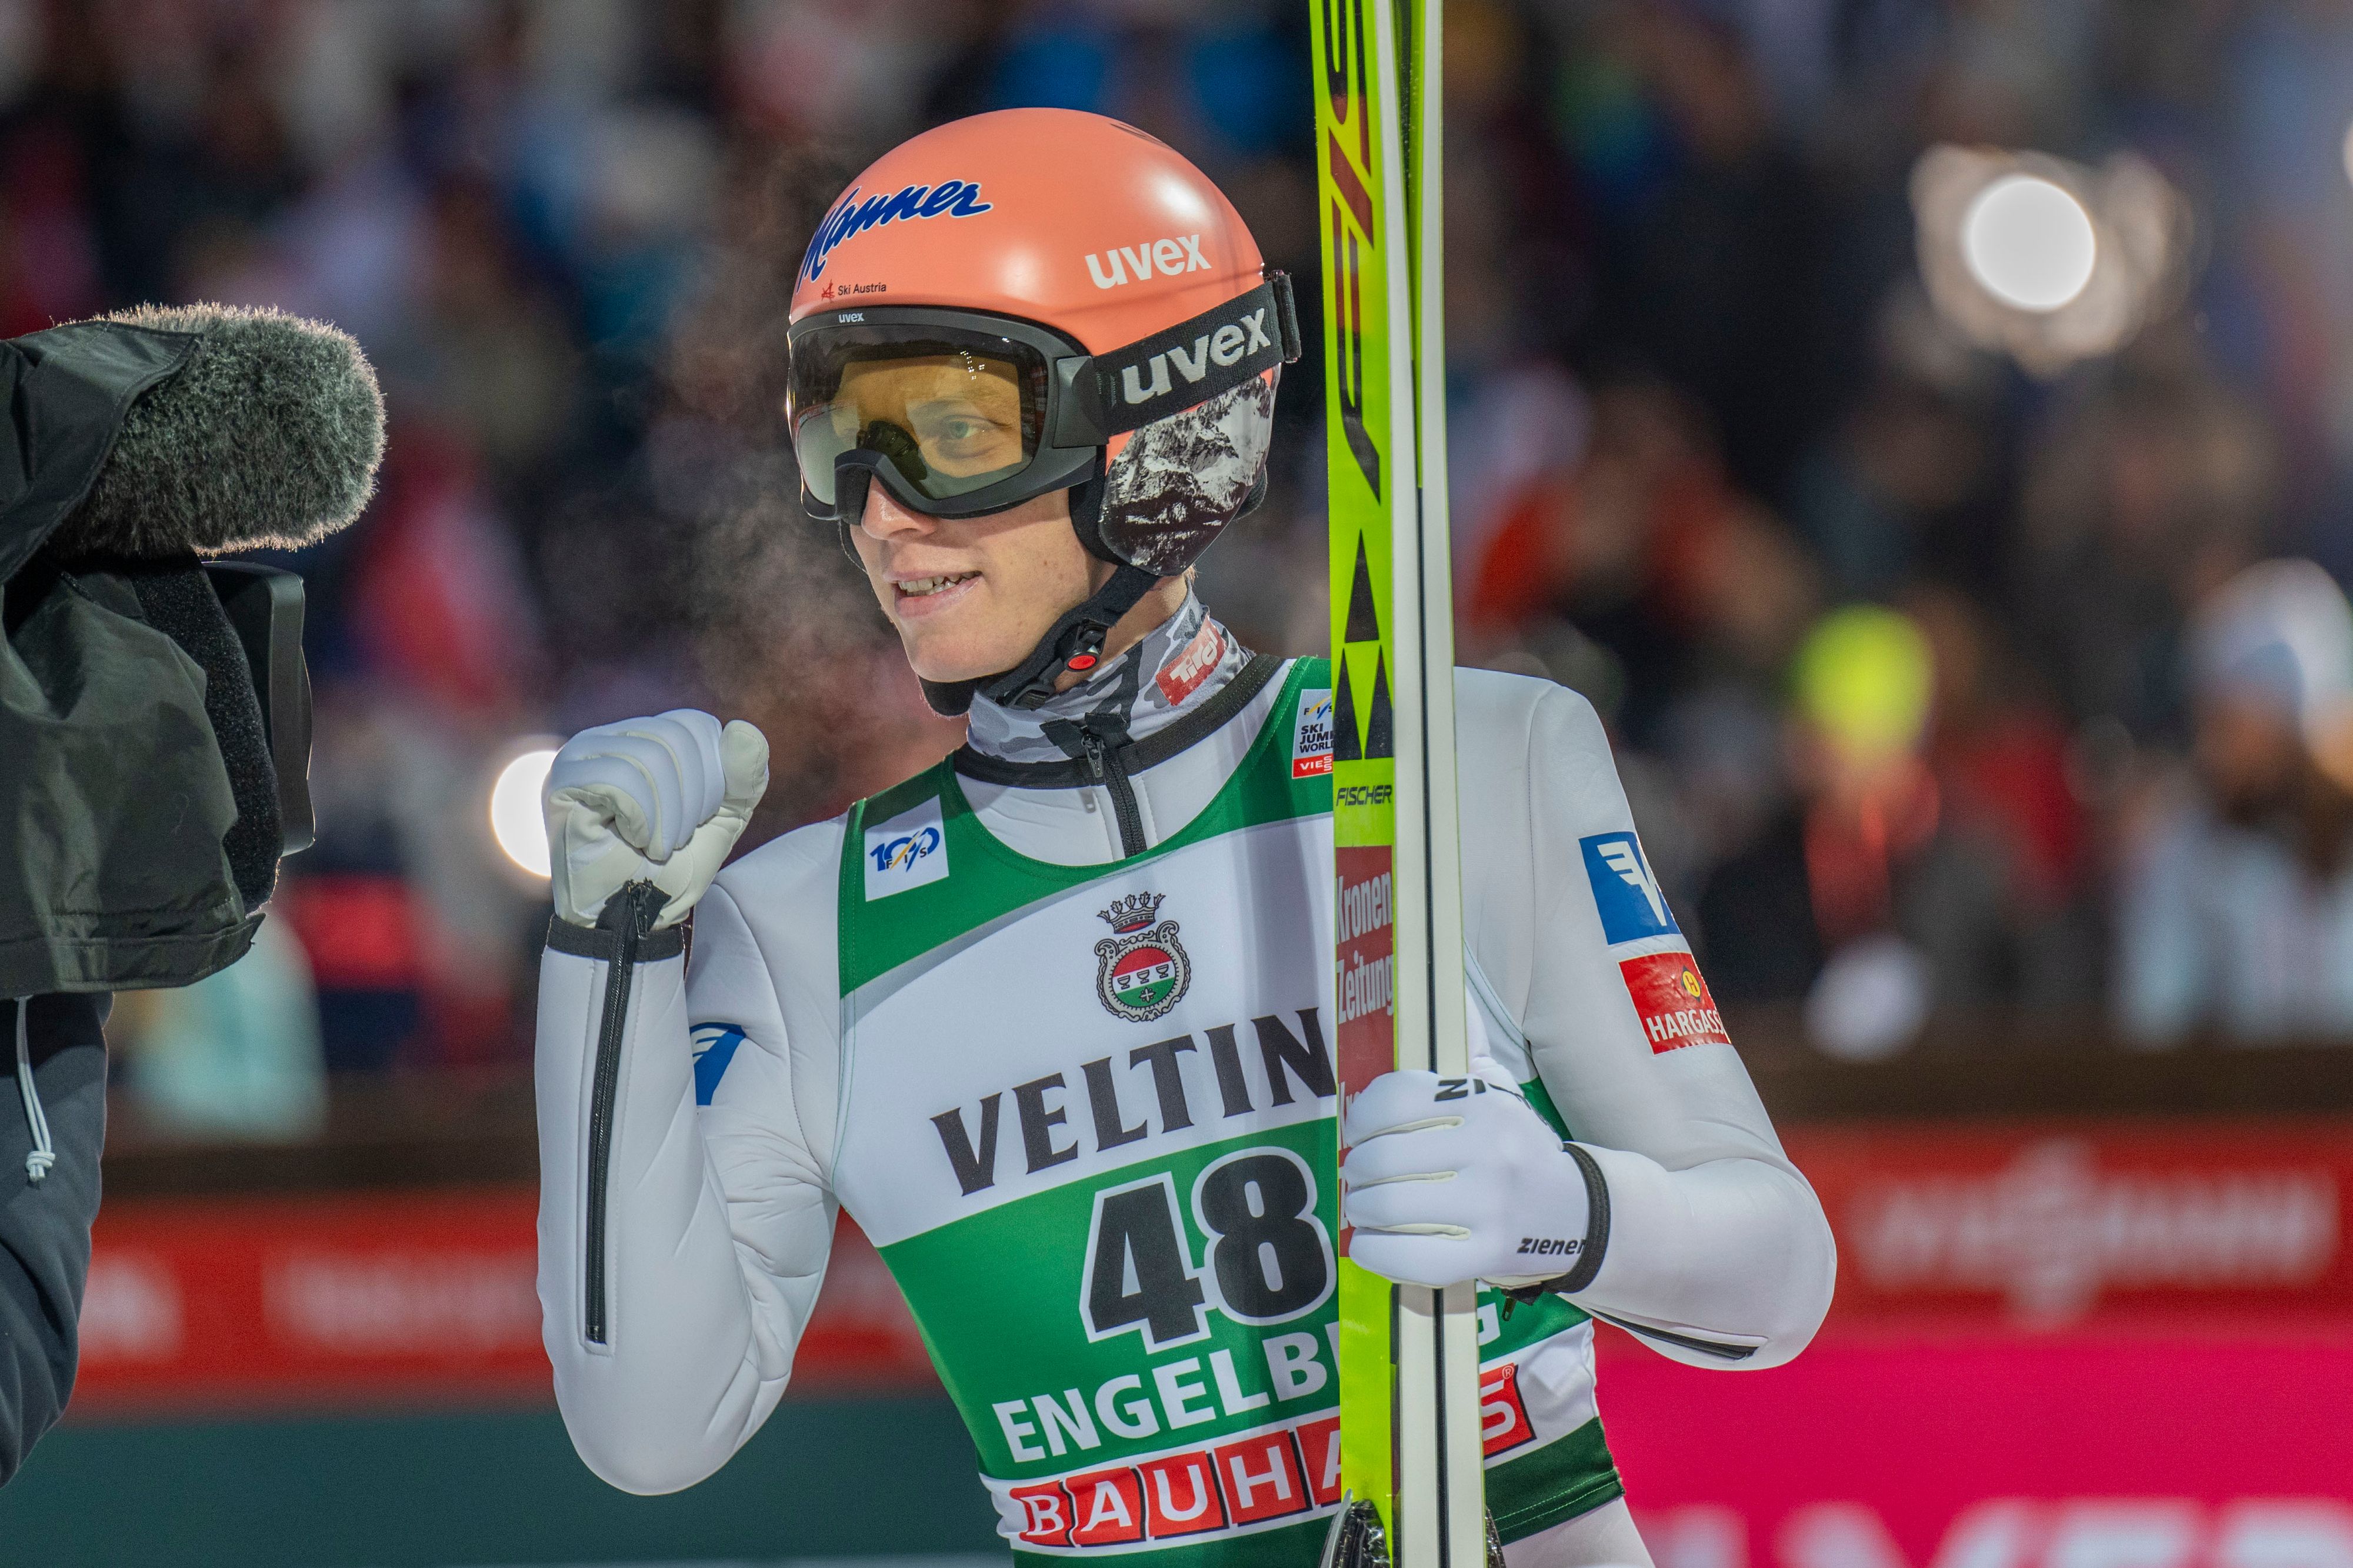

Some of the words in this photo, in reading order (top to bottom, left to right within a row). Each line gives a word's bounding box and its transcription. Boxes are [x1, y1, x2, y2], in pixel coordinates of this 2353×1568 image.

[796, 179, 992, 293] Manner
[1085, 235, 1212, 289] uvex
[838, 285, 851, 296] Ski
[853, 282, 886, 293] Austria
[838, 312, 865, 323] uvex
[1122, 308, 1271, 404] uvex
[1301, 723, 1324, 735] SKI
[1336, 785, 1392, 806] FISCHER
[1337, 872, 1392, 945] Kronen
[1337, 950, 1394, 1025] Zeitung
[929, 1007, 1337, 1196] VELTIN
[1081, 1147, 1335, 1353] 48
